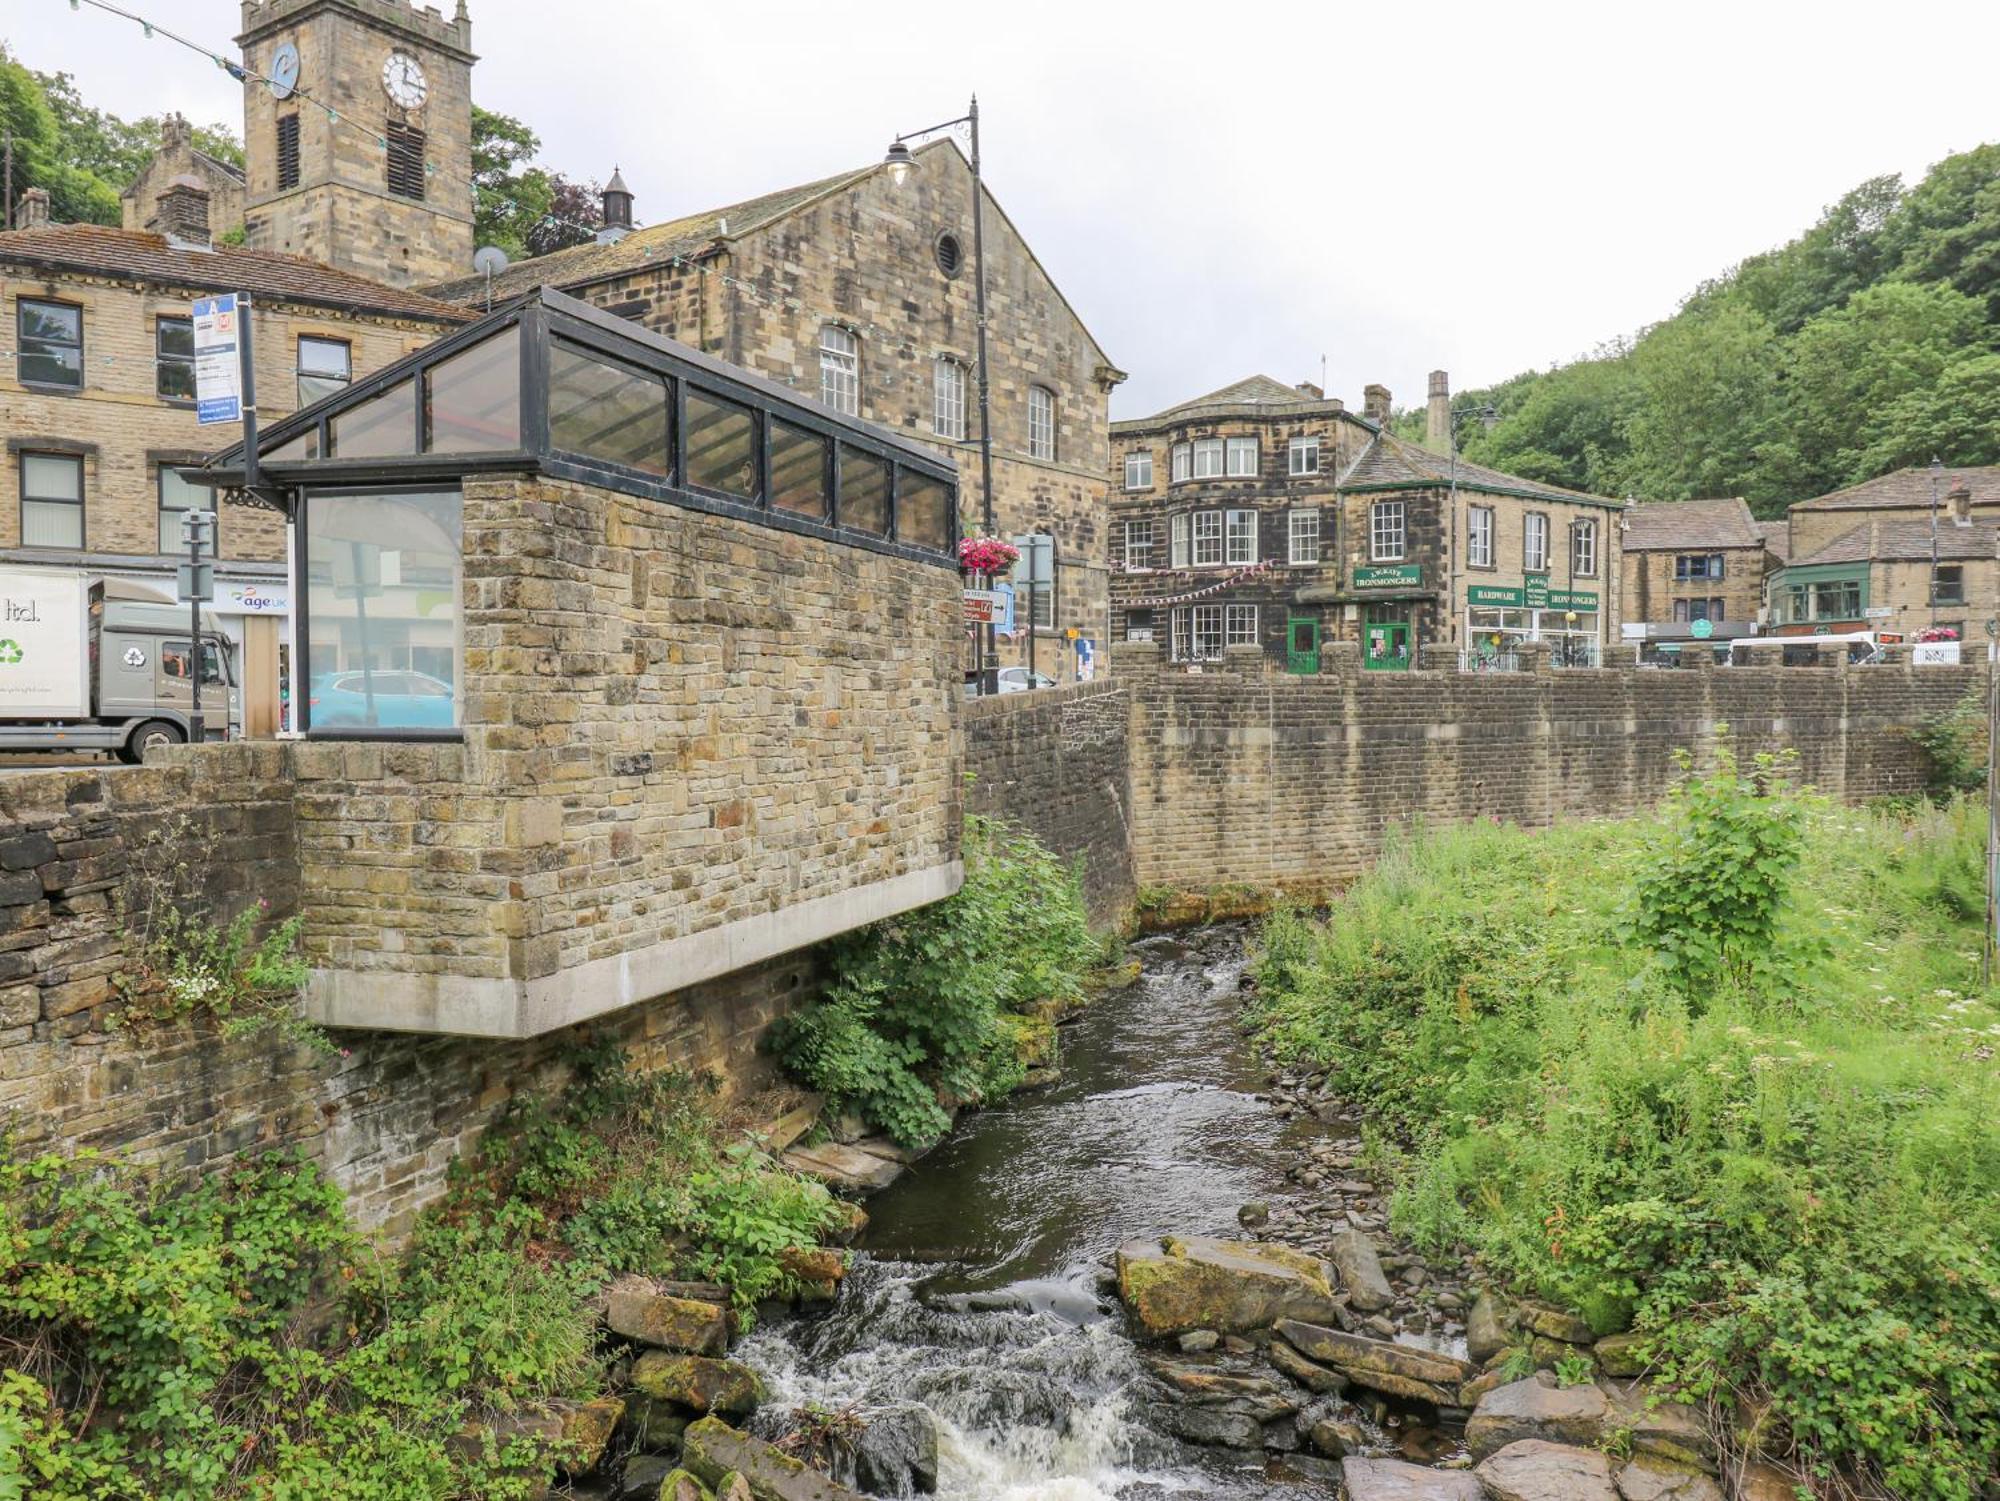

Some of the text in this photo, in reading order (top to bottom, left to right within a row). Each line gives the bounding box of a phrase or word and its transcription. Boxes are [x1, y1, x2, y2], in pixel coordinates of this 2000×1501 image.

[1356, 577, 1417, 587] IRONMONGERS
[1477, 590, 1516, 601] HARDWARE
[244, 597, 271, 610] age
[5, 598, 41, 622] ltd.
